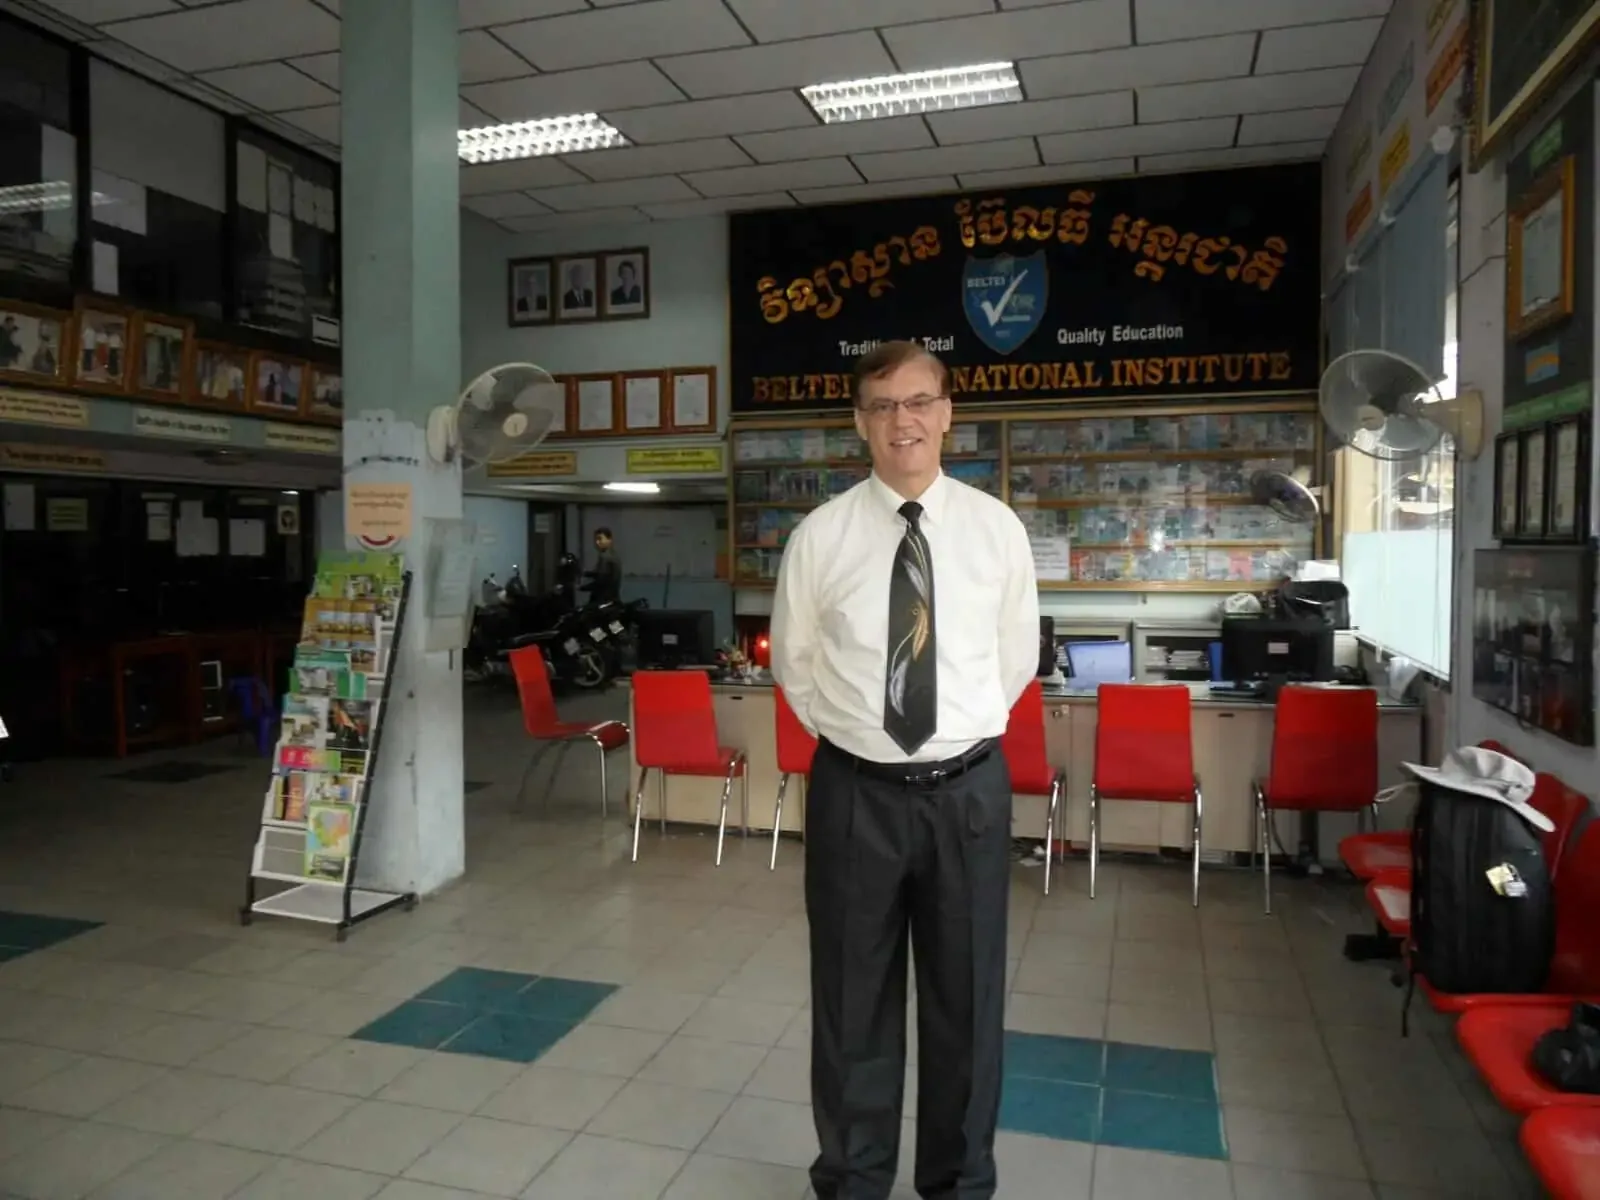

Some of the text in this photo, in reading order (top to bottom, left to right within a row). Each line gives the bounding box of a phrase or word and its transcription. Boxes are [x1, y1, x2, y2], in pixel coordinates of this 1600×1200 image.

[967, 275, 1006, 289] BELTEI
[922, 335, 954, 353] Total
[1057, 327, 1107, 347] Quality
[1112, 324, 1184, 343] Education
[752, 350, 1293, 402] BELTEI NATIONAL INSTITUTE
